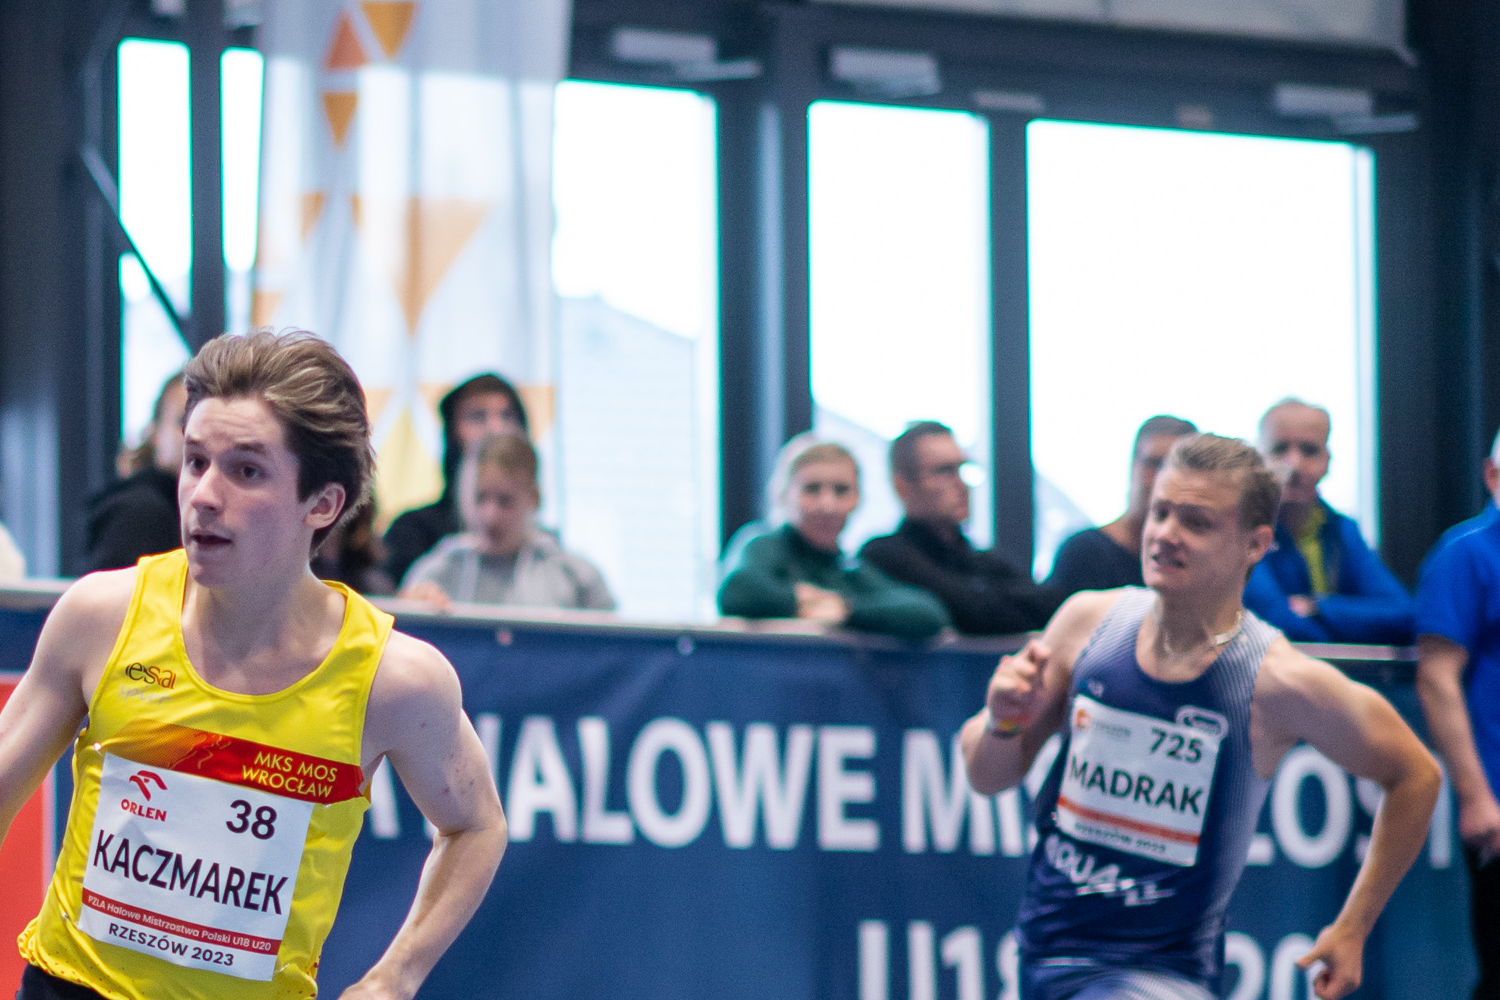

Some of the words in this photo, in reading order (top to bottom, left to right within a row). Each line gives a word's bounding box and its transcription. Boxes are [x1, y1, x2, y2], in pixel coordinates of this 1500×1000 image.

[1150, 728, 1203, 763] 725
[242, 765, 333, 798] WROCŁAW
[254, 751, 293, 773] MKS
[297, 761, 338, 782] MOS
[1069, 755, 1204, 816] MADRAK
[120, 798, 168, 822] ORLEN
[225, 799, 278, 840] 38
[92, 829, 289, 915] KACZMAREK
[88, 895, 106, 910] PZLA
[107, 903, 141, 921] Halowe
[142, 914, 200, 938] Mistrzostwa
[201, 930, 231, 944] Polski
[232, 936, 250, 948] U18
[252, 940, 272, 951] U20
[108, 923, 189, 956] RZESZÓW
[191, 946, 234, 967] 2023
